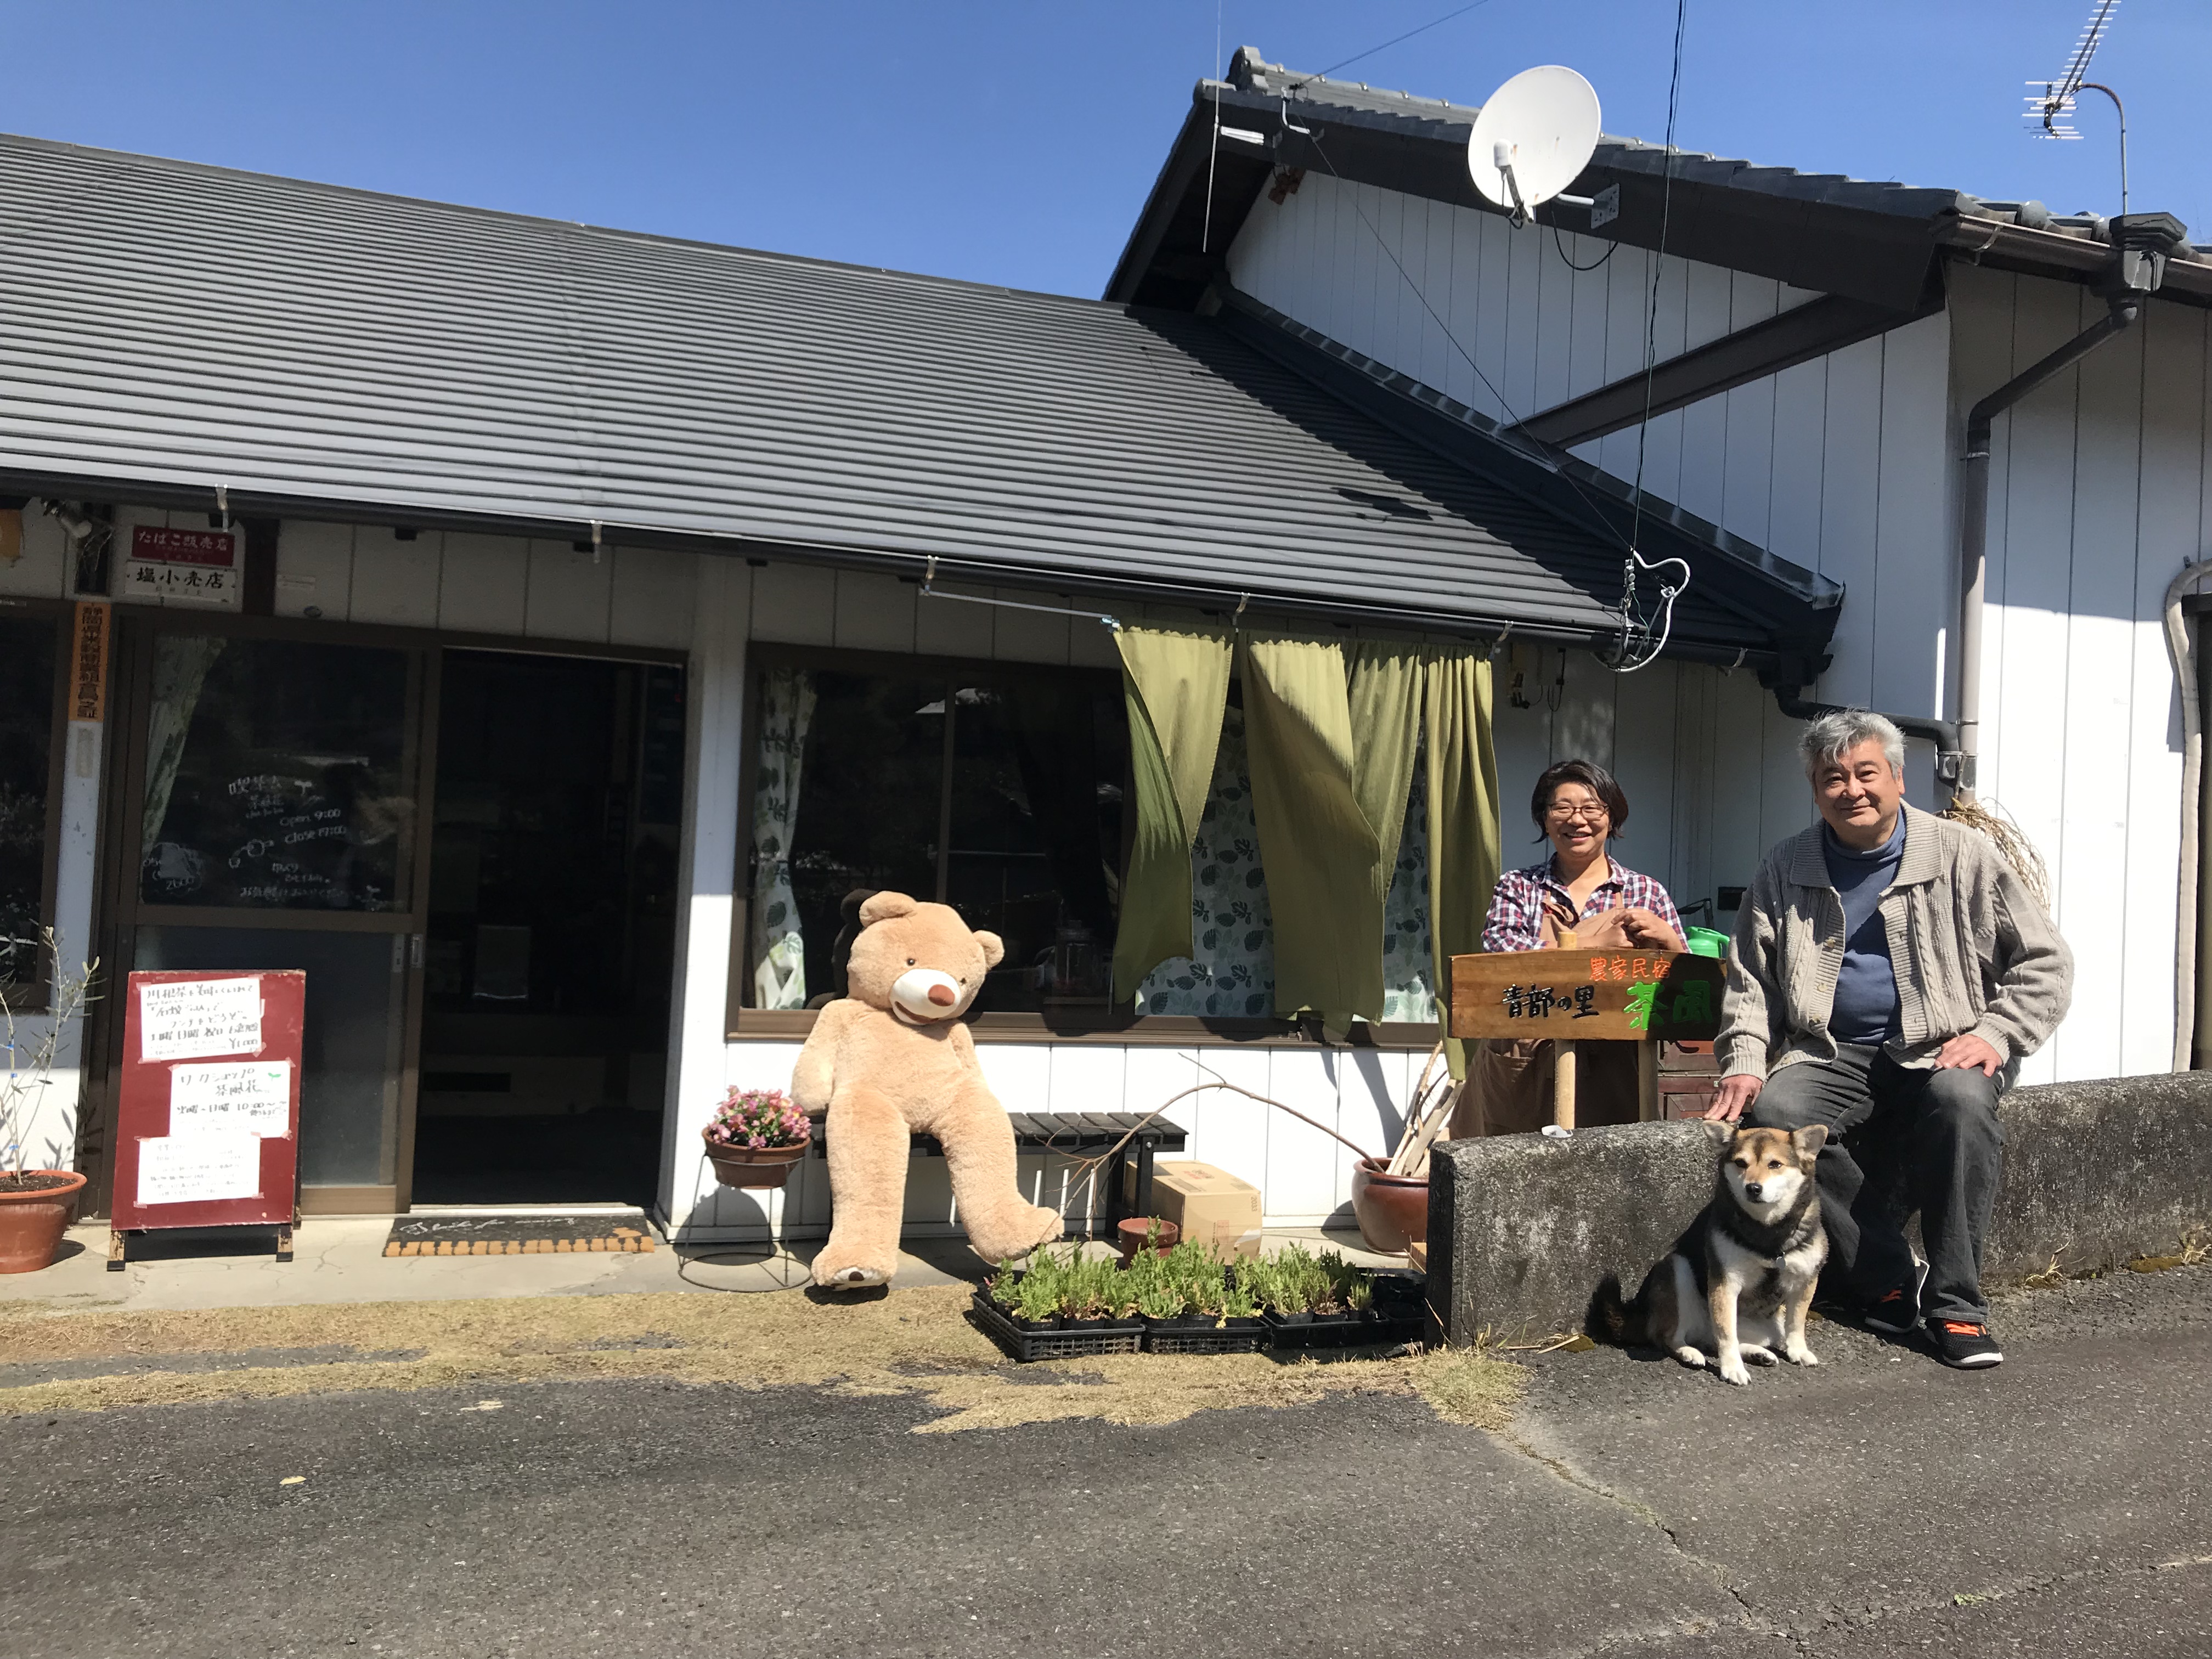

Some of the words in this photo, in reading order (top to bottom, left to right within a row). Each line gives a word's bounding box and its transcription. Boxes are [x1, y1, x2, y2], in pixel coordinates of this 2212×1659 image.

[138, 530, 228, 551] たばこ販売店
[136, 566, 224, 589] 塩小売店
[314, 808, 341, 821] 9:00
[1589, 956, 1672, 981] 農家民宿
[1502, 983, 1600, 1019] 青部の里
